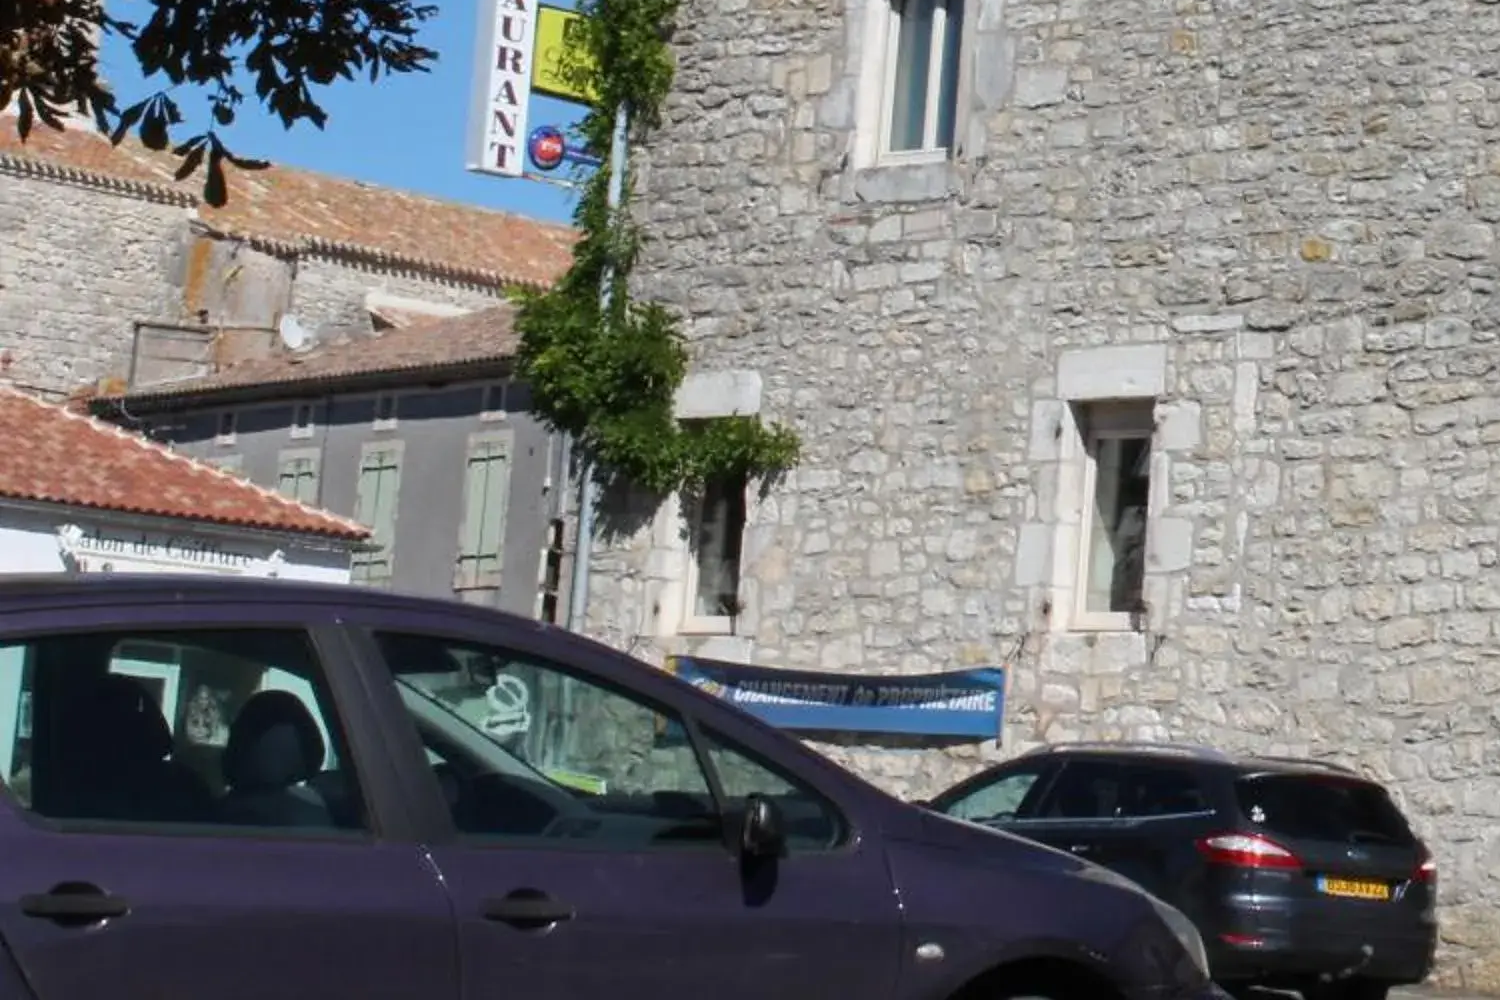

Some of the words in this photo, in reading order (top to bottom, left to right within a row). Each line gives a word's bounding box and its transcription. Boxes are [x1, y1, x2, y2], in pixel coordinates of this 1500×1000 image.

[79, 527, 126, 553] alon
[134, 531, 159, 556] de
[165, 535, 253, 567] Coiffure
[735, 679, 849, 707] CHANGEMENT
[854, 683, 876, 705] de
